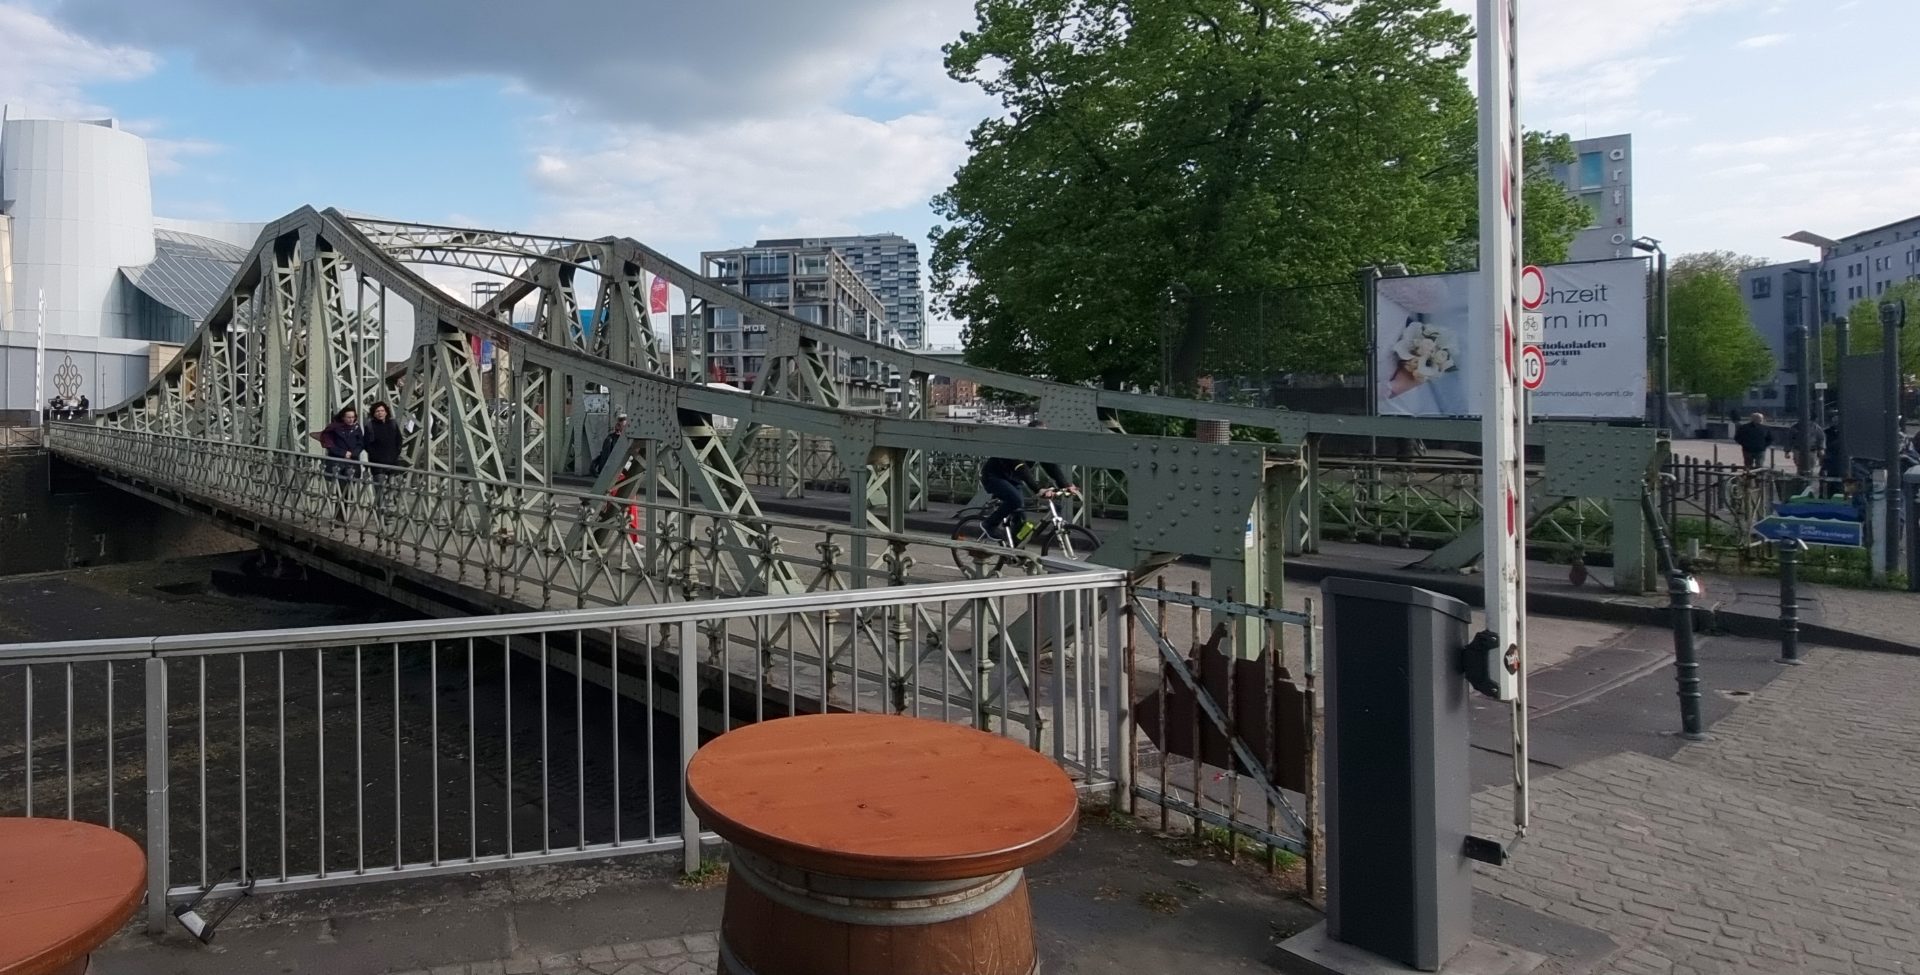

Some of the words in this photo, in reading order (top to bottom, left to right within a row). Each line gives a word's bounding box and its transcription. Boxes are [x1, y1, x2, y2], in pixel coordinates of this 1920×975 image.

[1541, 284, 1608, 305] chzeit
[1578, 310, 1608, 328] im
[1537, 340, 1607, 349] chokoladen
[1541, 349, 1581, 357] useum
[1525, 358, 1538, 377] 10
